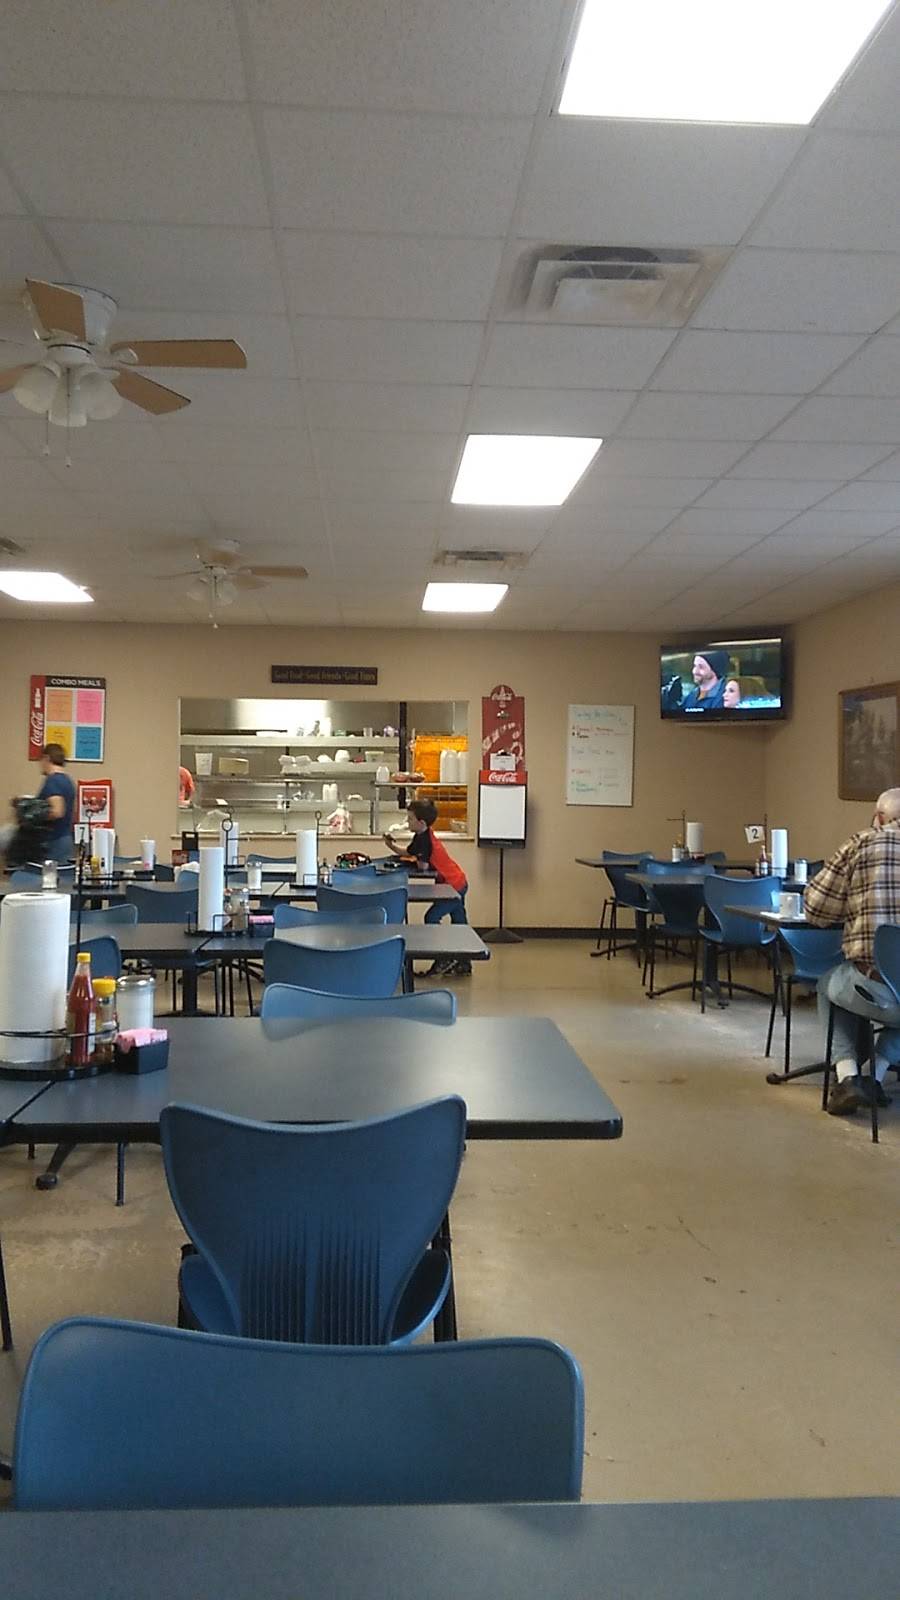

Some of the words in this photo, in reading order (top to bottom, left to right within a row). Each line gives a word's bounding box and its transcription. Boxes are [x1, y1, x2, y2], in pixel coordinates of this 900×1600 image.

[51, 678, 77, 686] COMBO
[78, 679, 101, 687] MEALS
[79, 827, 85, 840] 7
[751, 828, 760, 839] 2
